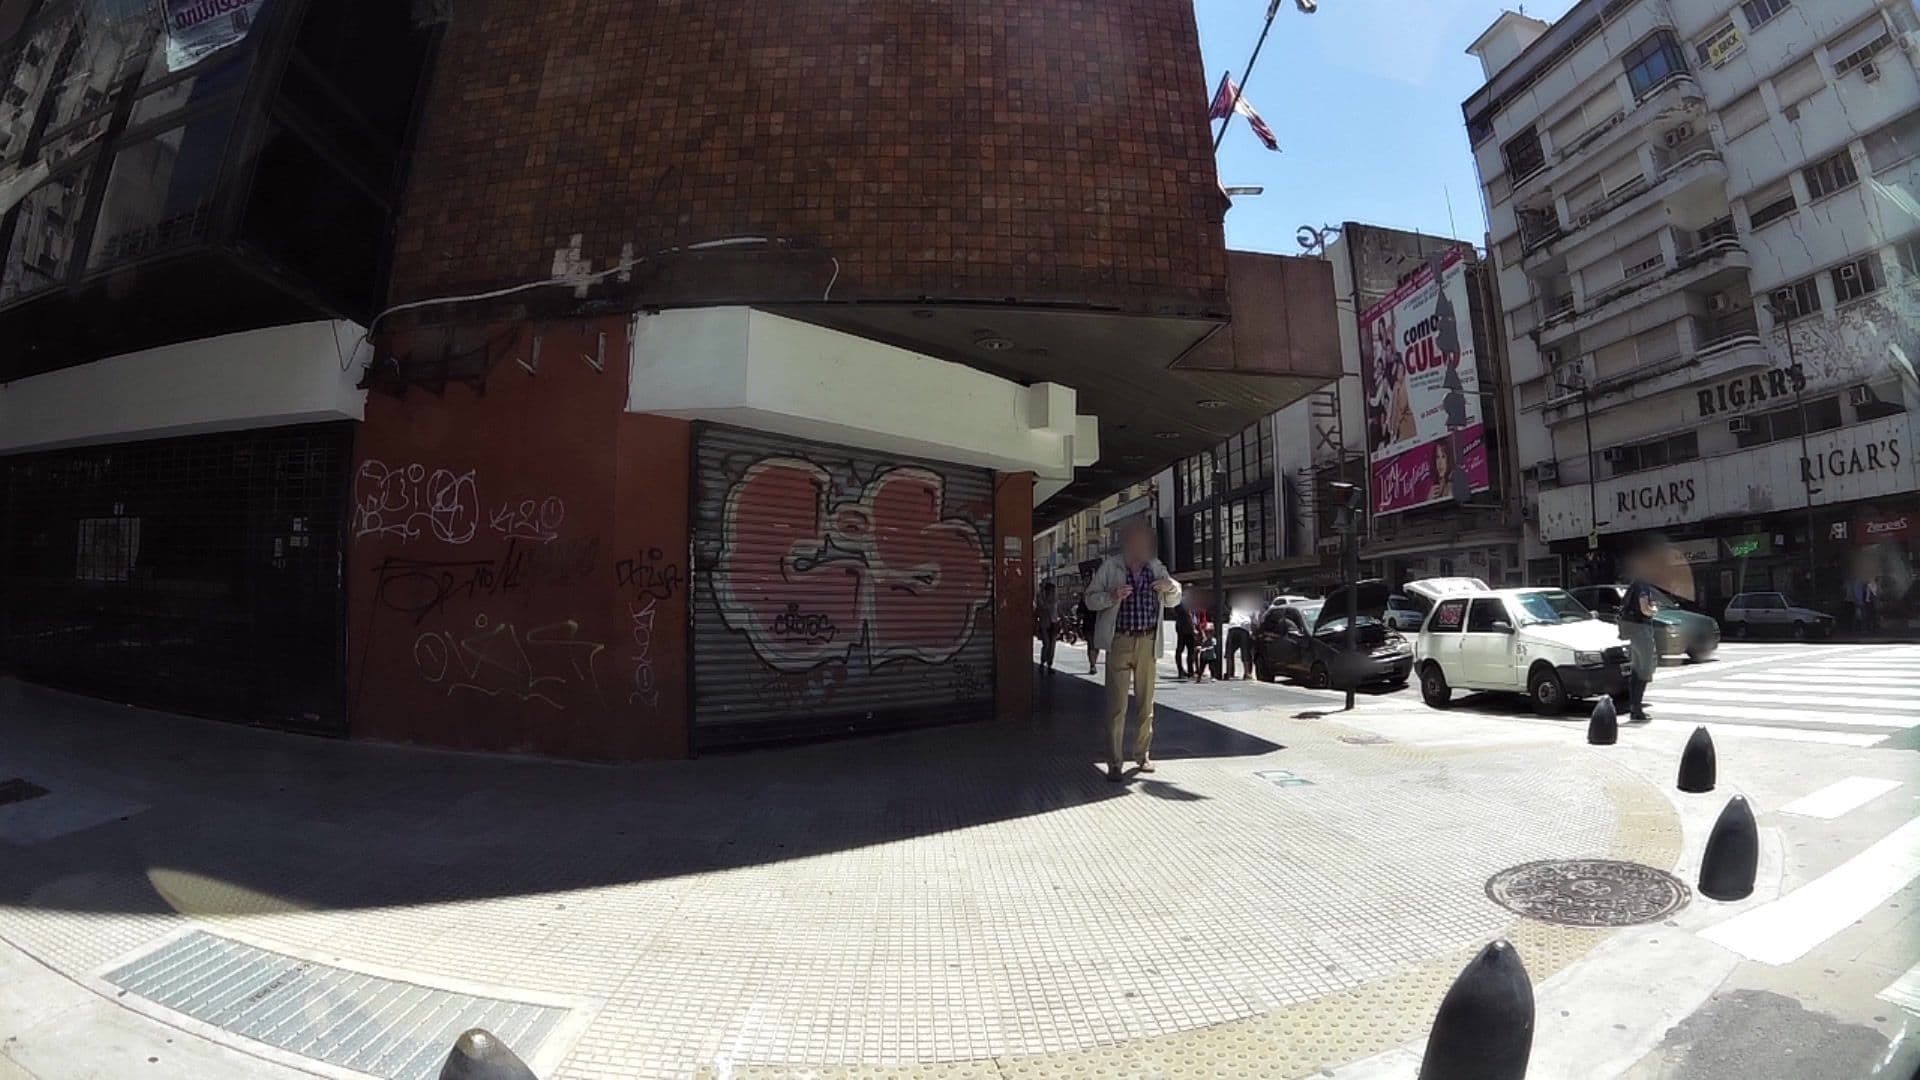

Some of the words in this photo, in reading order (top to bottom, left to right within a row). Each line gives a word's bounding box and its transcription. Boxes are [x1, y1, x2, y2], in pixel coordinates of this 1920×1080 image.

[1697, 363, 1806, 416] RIGAR'S
[1800, 439, 1901, 483] RIGAR'S
[1616, 478, 1696, 513] RIGAR'S
